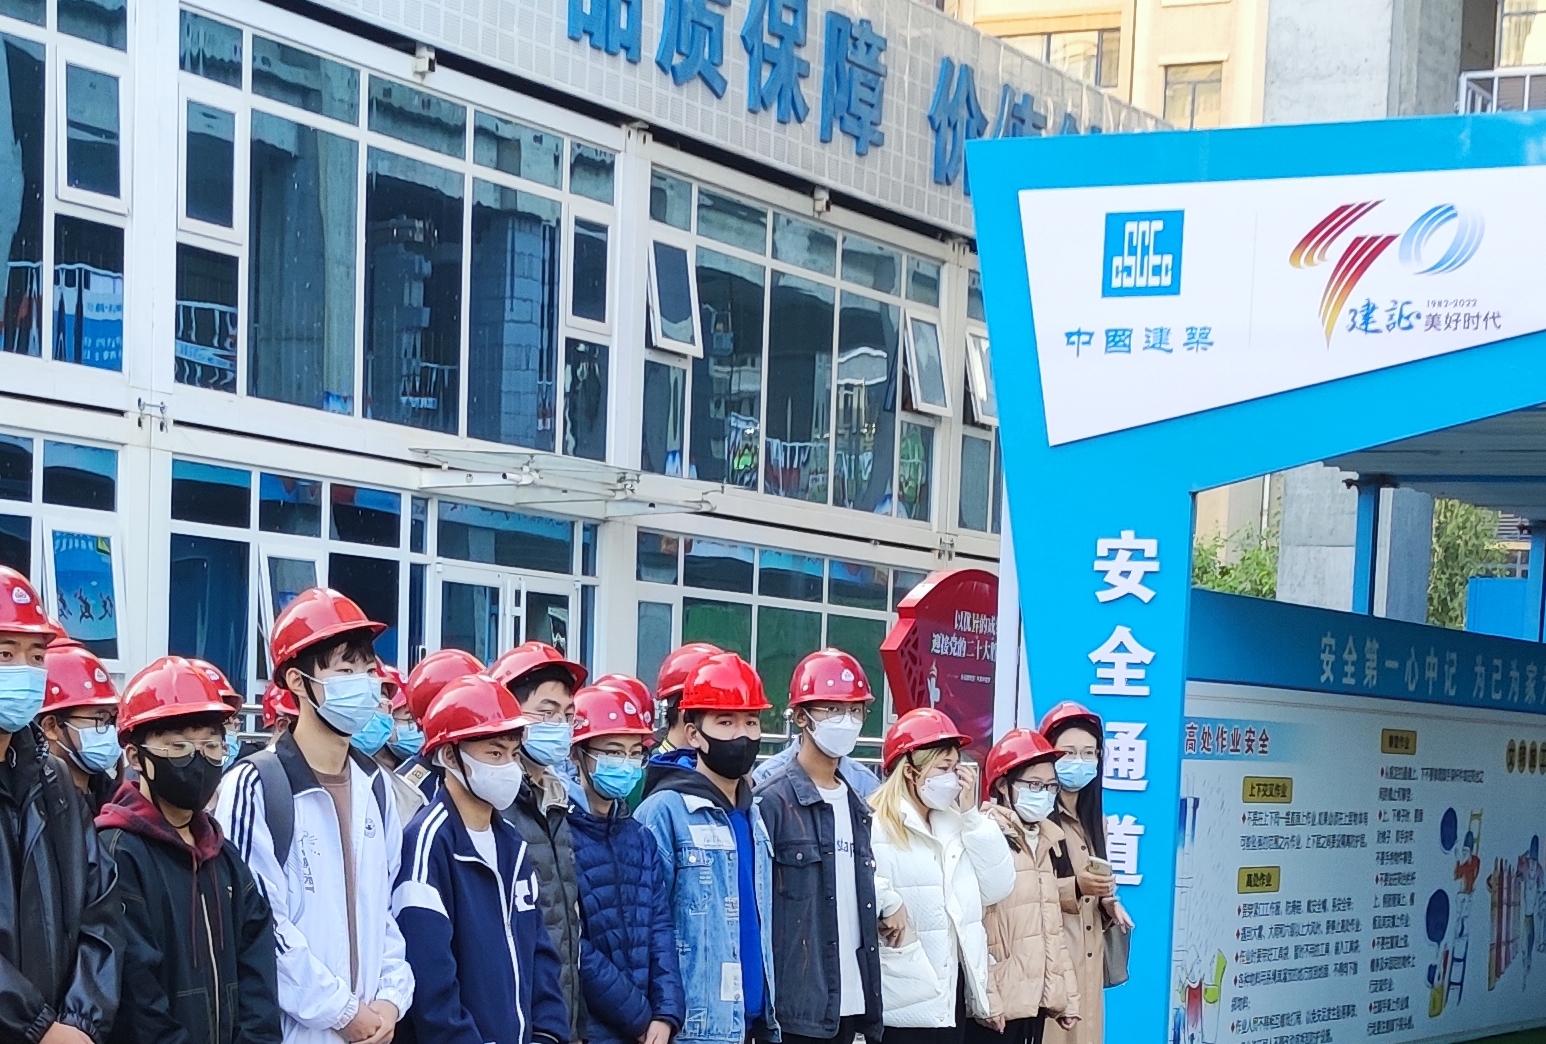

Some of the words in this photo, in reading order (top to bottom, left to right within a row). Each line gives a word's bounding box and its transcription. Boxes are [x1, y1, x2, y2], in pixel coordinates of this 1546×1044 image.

[1423, 311, 1502, 332] 美好时代
[954, 609, 998, 636] 以优异的成
[1320, 631, 1457, 697] 安全第一心中记
[1087, 530, 1161, 886] 安全通道
[1184, 722, 1270, 755] 高处作业安全
